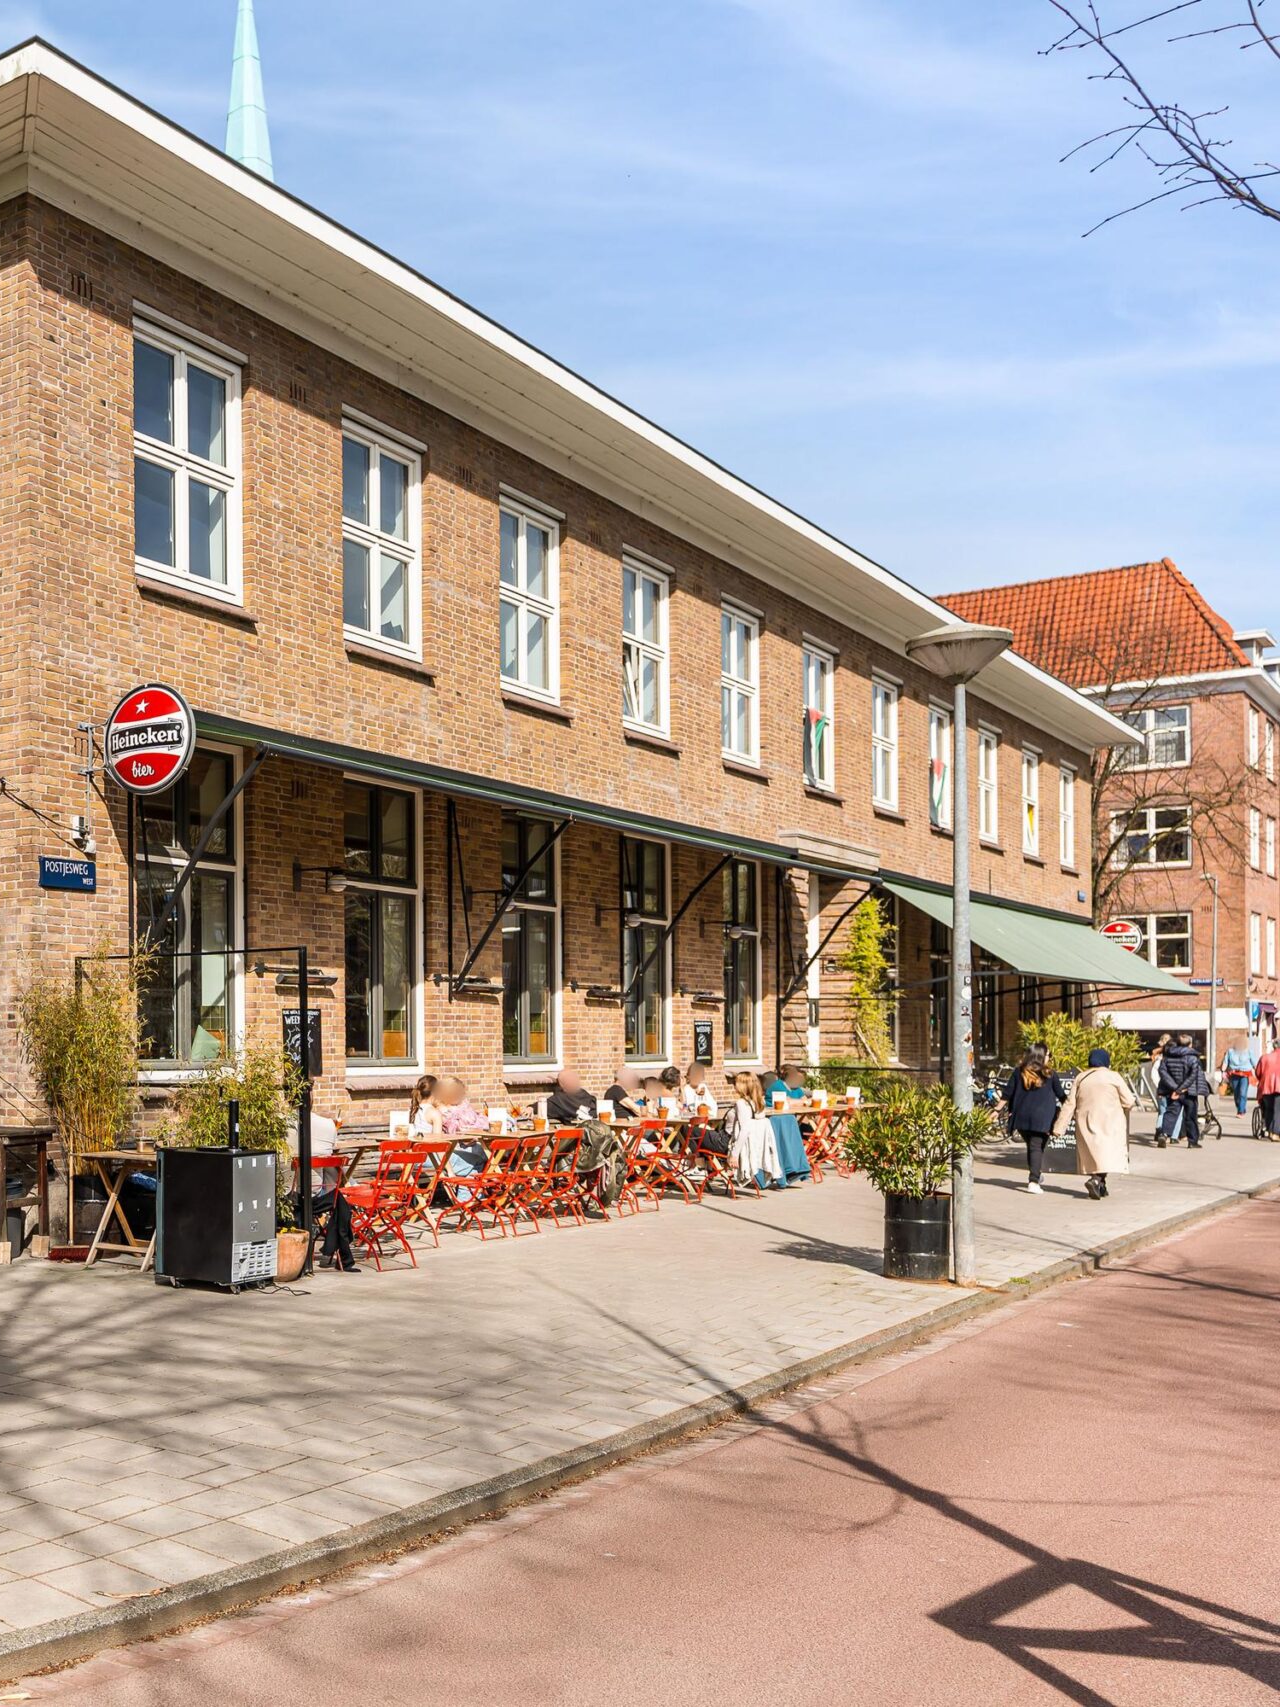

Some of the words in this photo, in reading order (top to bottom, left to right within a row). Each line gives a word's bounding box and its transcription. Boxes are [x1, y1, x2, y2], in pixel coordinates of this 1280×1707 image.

[111, 727, 180, 752] Heineken
[131, 760, 155, 778] bier
[45, 860, 89, 877] POSTJESWEG
[82, 877, 94, 886] WEST
